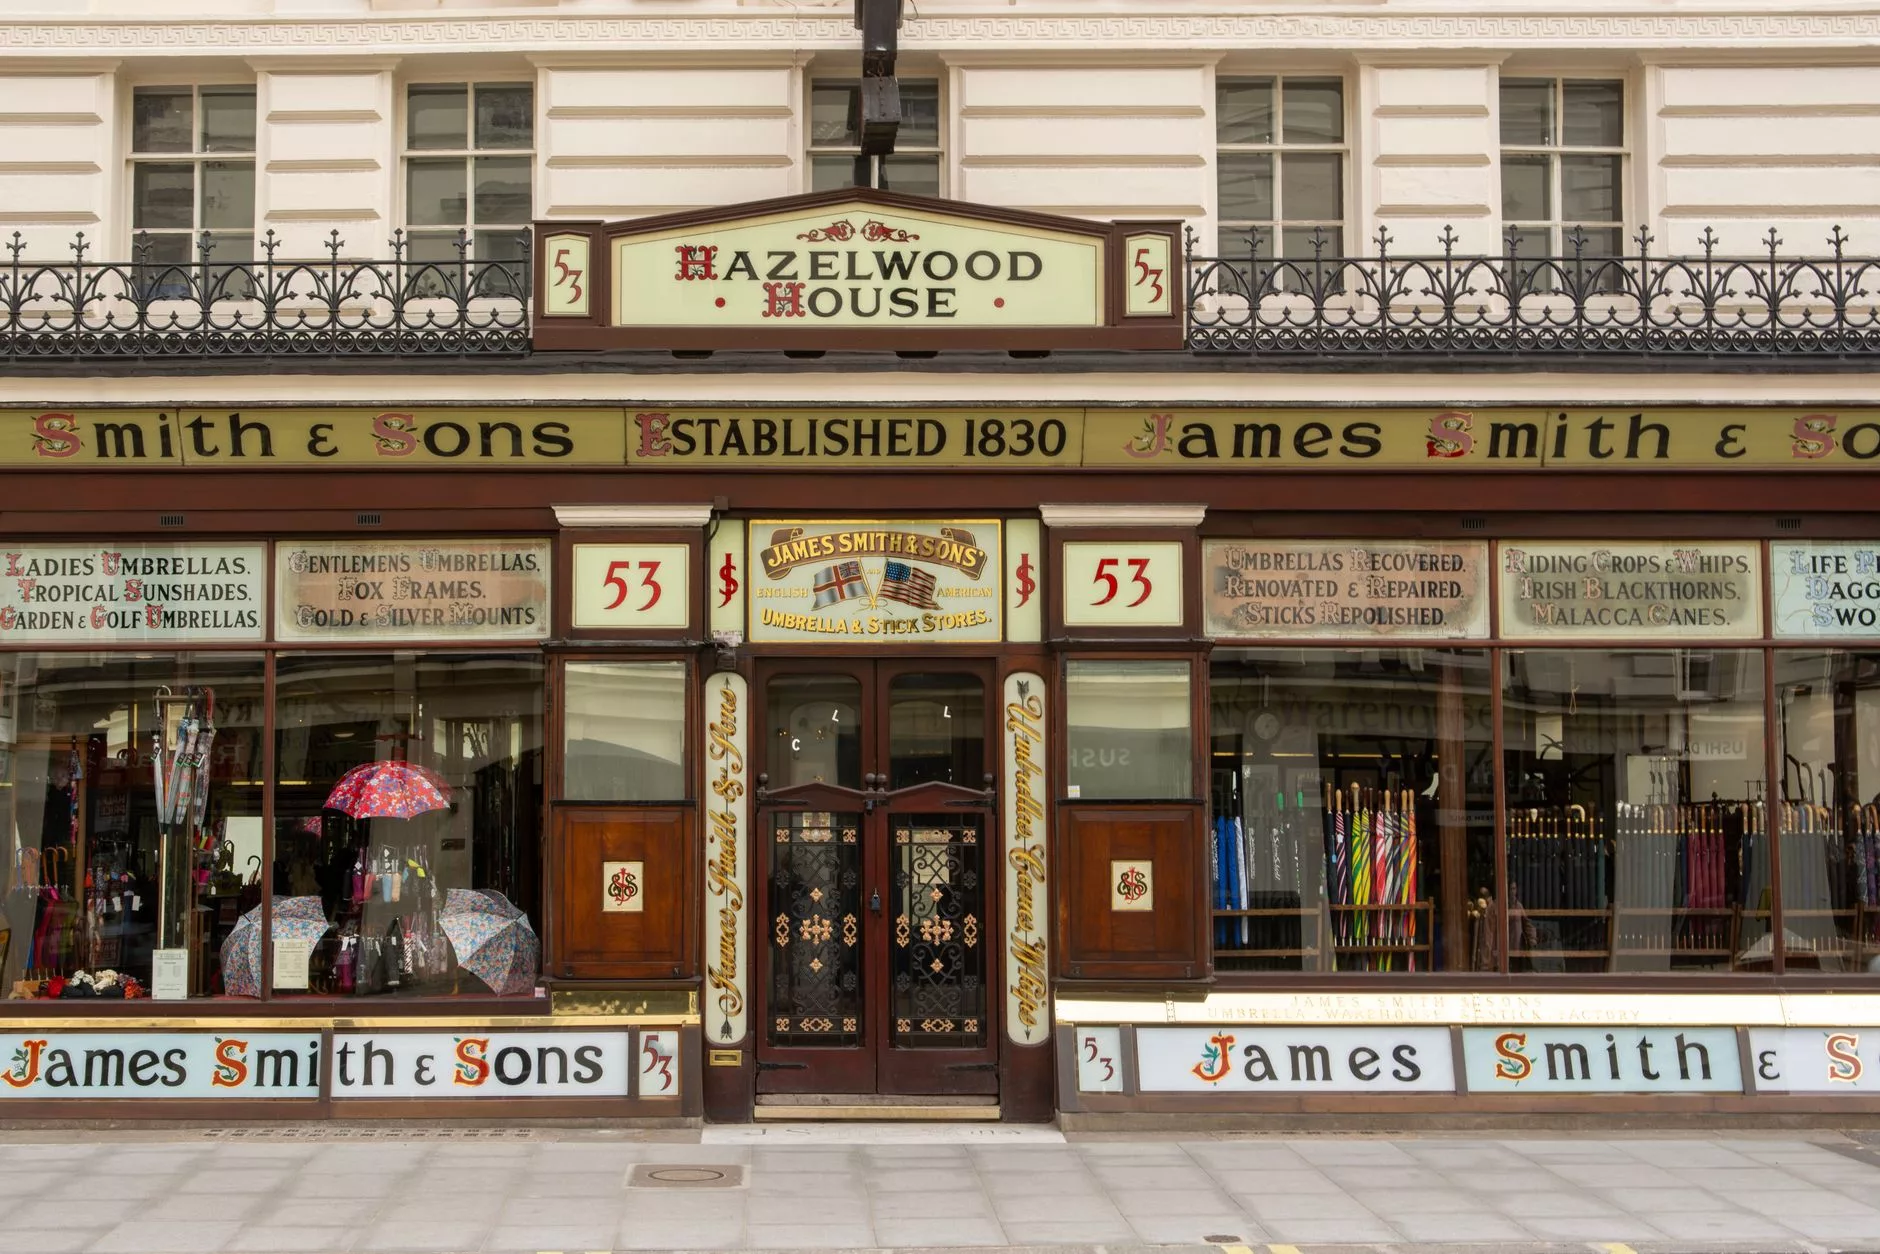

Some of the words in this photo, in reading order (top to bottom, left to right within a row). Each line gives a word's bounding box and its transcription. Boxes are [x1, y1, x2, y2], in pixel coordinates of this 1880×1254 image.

[553, 249, 583, 304] 53
[674, 244, 1044, 281] HAZELWOOD
[1134, 248, 1164, 303] 53
[762, 281, 958, 318] HOUSE
[31, 412, 276, 458] Smith
[371, 412, 574, 458] Sons
[635, 412, 947, 457] ESTABLISHED
[963, 418, 1067, 456] 1830
[1122, 413, 1382, 458] James
[1424, 411, 1669, 458] Smith
[768, 535, 834, 567] JAMES
[839, 532, 902, 554] SMITH
[1224, 547, 1343, 572] UMBRELLAS
[1505, 548, 1587, 575] RIDING
[1591, 550, 1660, 574] CROPS
[1790, 549, 1849, 575] LIFE
[18, 578, 119, 603] TROPICAL
[338, 576, 384, 600] FOX
[603, 561, 661, 611] 53
[755, 588, 808, 598] ENGLISH
[936, 587, 993, 598] AMERICAN
[1090, 558, 1152, 608] 53
[1224, 574, 1338, 598] RENOVATED
[1520, 576, 1576, 600] IRISH
[0, 604, 74, 630] GARDEN
[90, 604, 141, 630] GOLF
[295, 604, 354, 629] GOLD
[375, 603, 444, 628] SILVER
[450, 602, 536, 626] MOUNTS
[761, 608, 848, 634] UMBRELLA
[851, 619, 864, 634] &
[867, 616, 920, 635] STICK
[1245, 601, 1316, 626] STICKS
[1532, 603, 1643, 626] MALACCA
[1, 1039, 187, 1089] James
[212, 1037, 394, 1089] Smith
[452, 1037, 604, 1088] Sons
[641, 1035, 673, 1091] 53
[1084, 1037, 1114, 1082] 53
[1191, 1031, 1422, 1086] James
[1494, 1032, 1712, 1086] Smith
